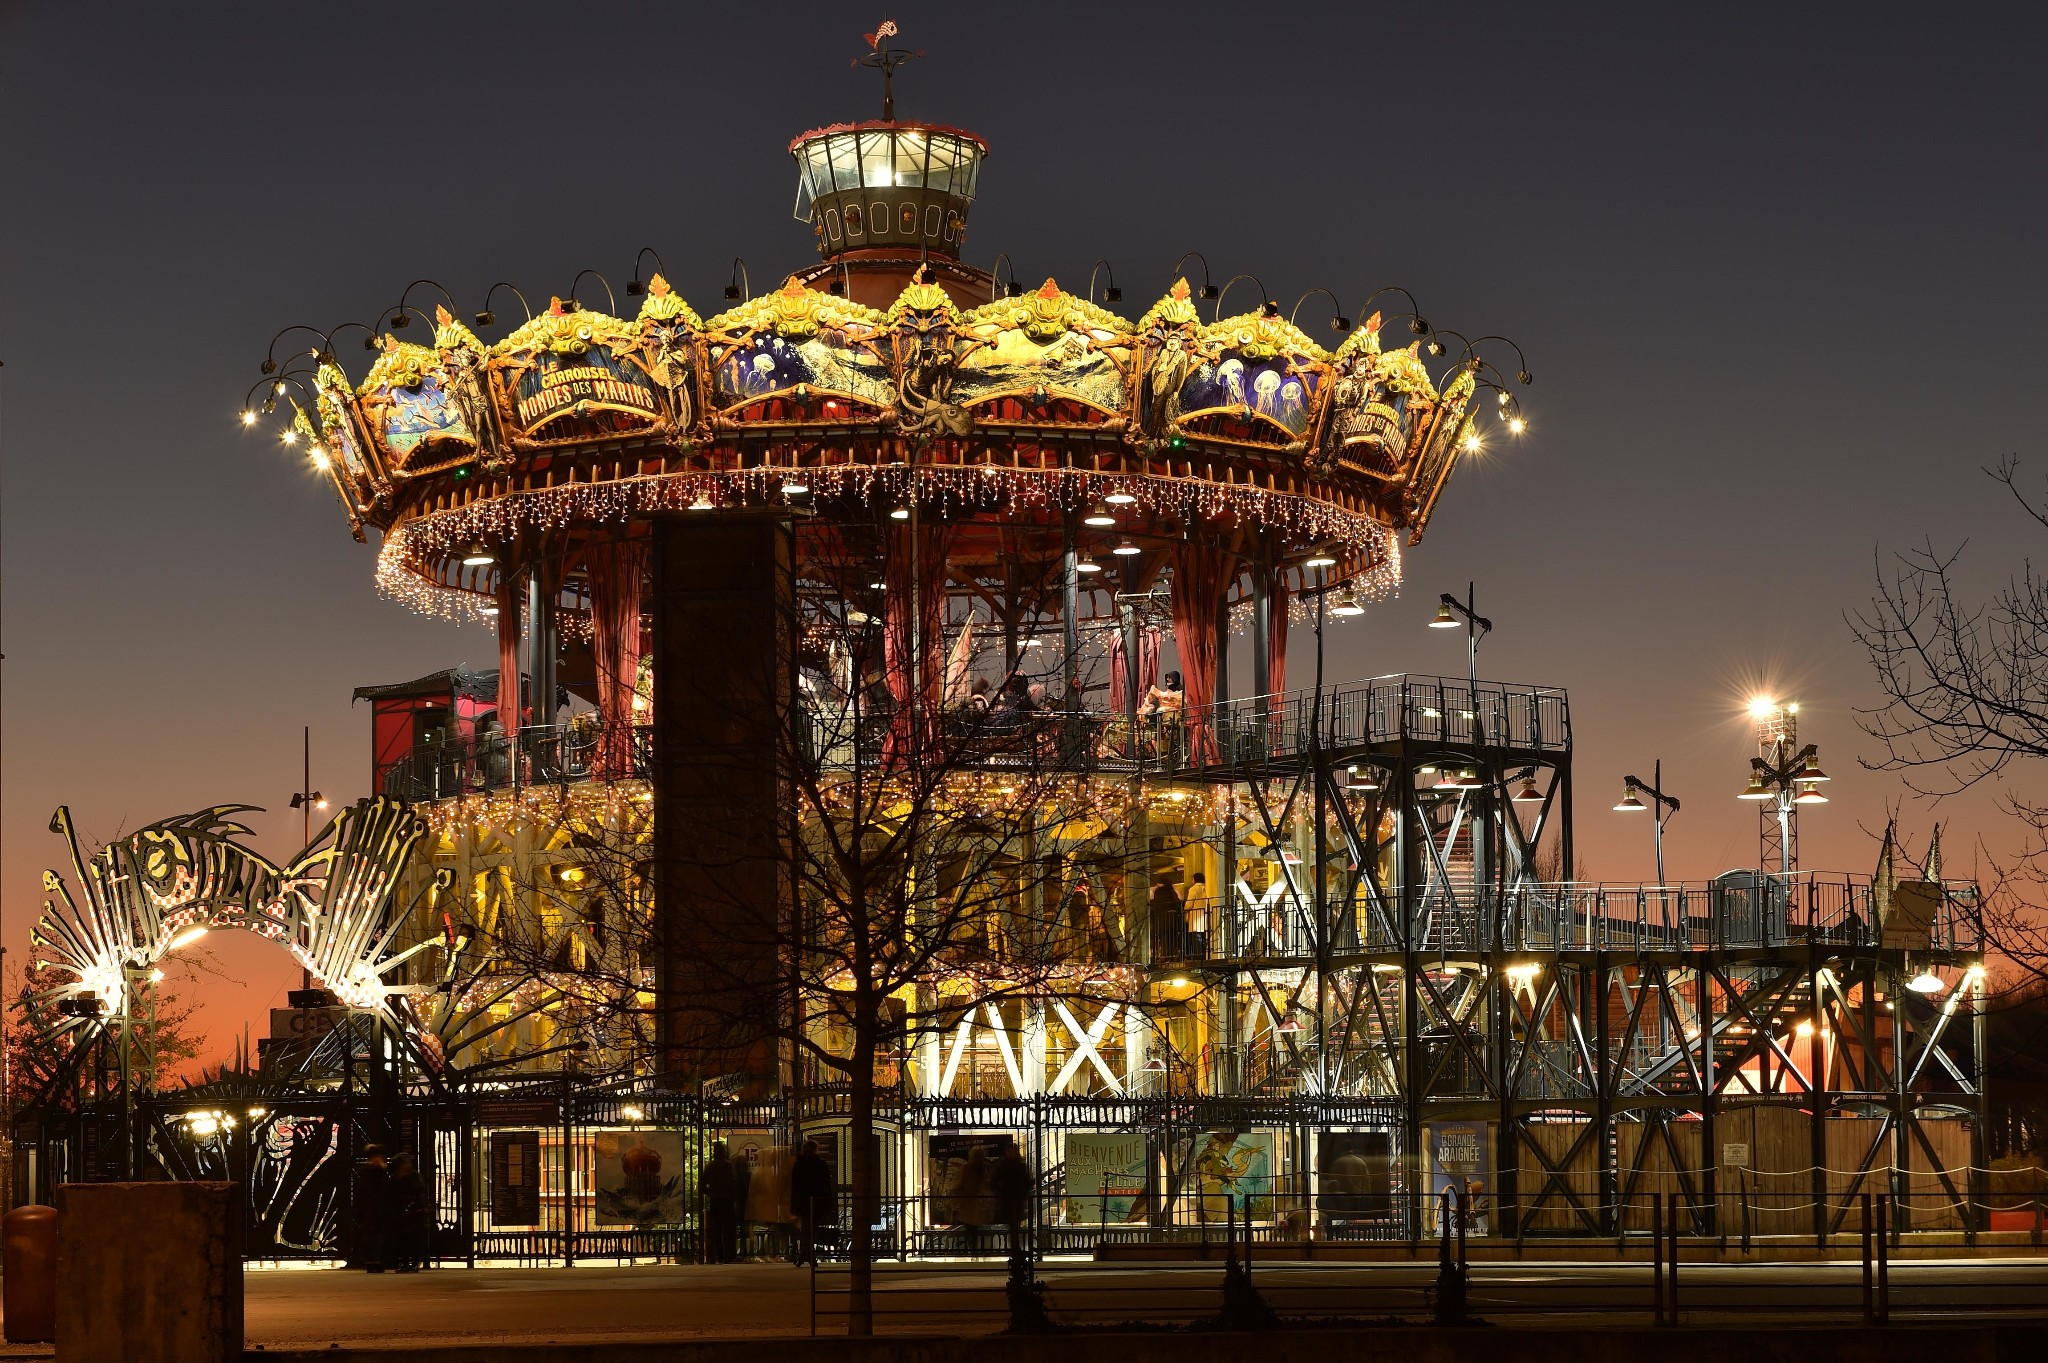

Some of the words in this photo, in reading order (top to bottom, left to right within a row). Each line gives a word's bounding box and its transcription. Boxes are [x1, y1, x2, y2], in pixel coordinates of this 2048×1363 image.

[540, 361, 559, 375] LE
[541, 366, 617, 390] CARROUSEL
[517, 384, 572, 426] MONDES
[572, 382, 592, 395] DES
[592, 381, 654, 409] MARINS
[1447, 1134, 1476, 1147] GRANDE
[744, 1148, 759, 1161] 15
[1070, 1140, 1140, 1166] BIENVENUE
[1438, 1145, 1480, 1162] ARAIGNÉE
[1069, 1158, 1092, 1166] AUX
[1099, 1180, 1113, 1188] DE
